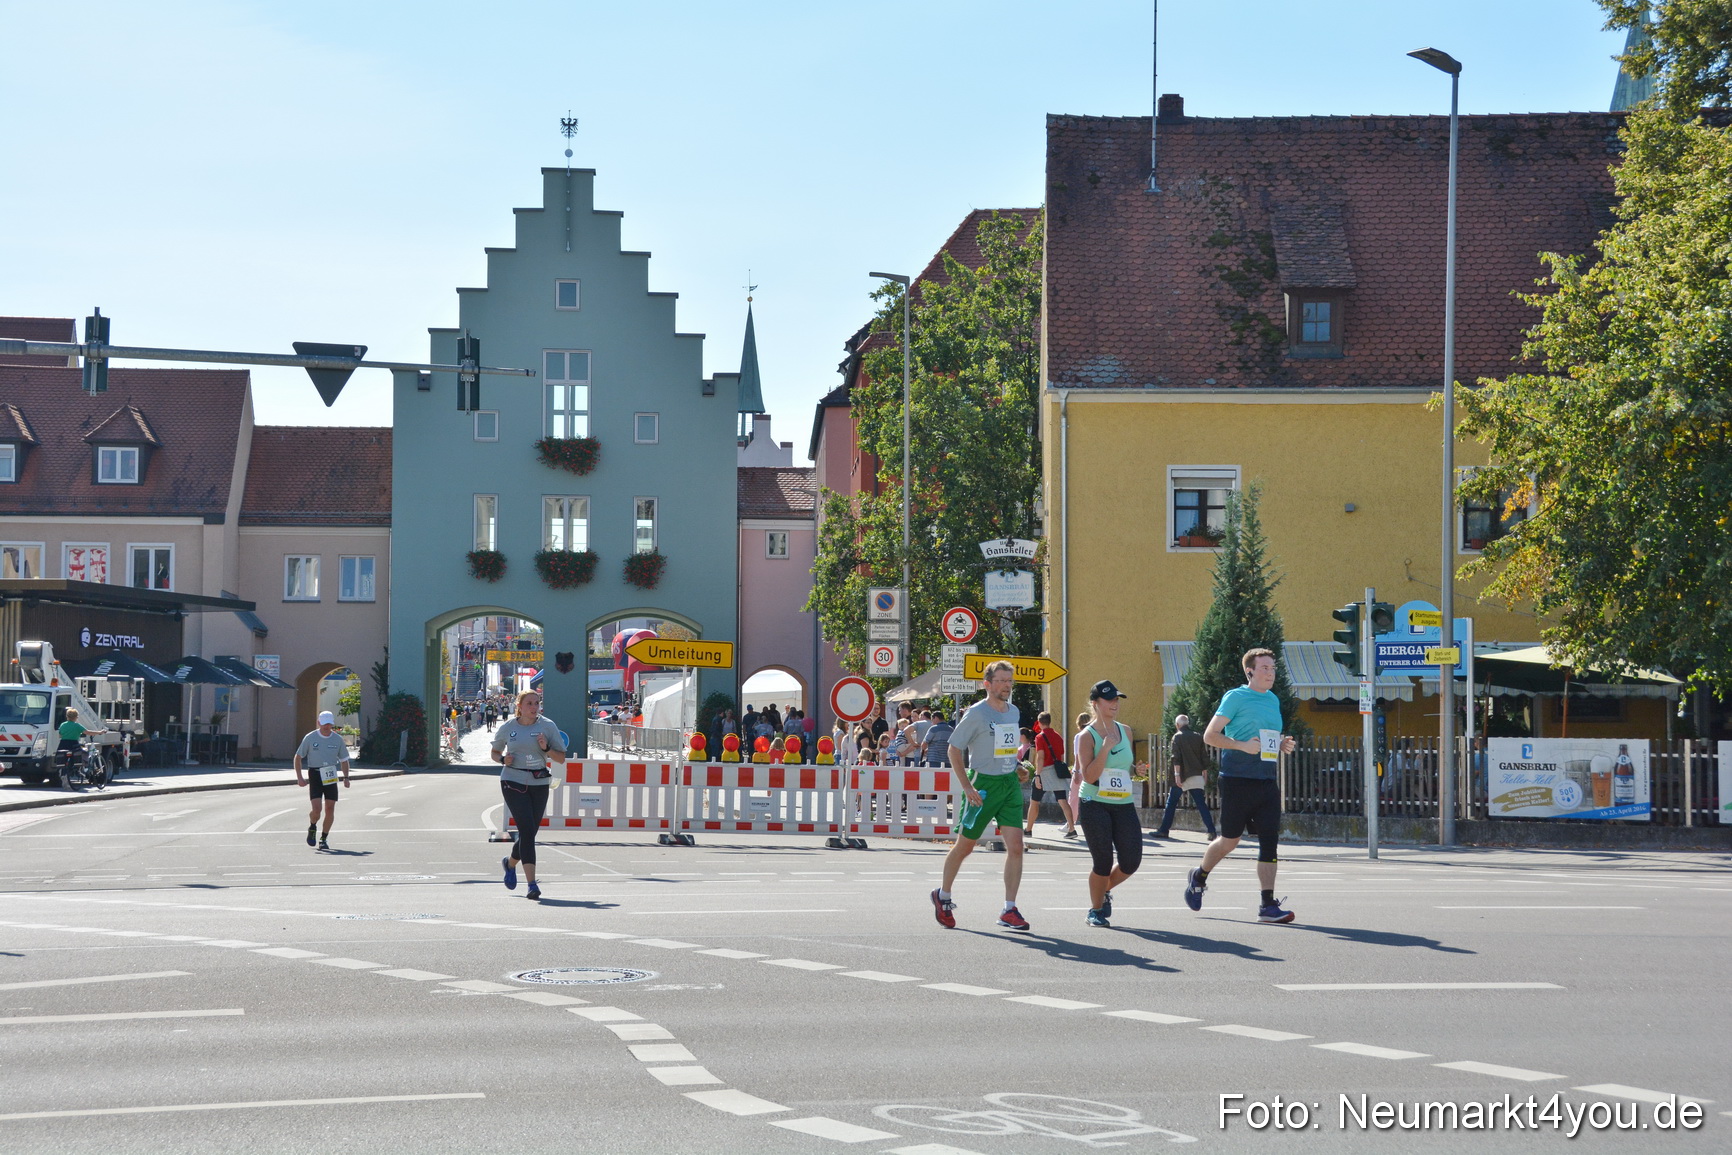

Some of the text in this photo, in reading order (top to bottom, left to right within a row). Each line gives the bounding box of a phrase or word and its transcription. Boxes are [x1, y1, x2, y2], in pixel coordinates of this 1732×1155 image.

[986, 546, 1033, 556] Ganskeller
[95, 633, 144, 649] ZENTRAL
[648, 645, 722, 665] Umleitung
[877, 653, 890, 662] 30
[975, 661, 1045, 680] Utung
[1004, 733, 1014, 744] 23
[1268, 738, 1276, 748] 21
[1110, 777, 1122, 788] 63
